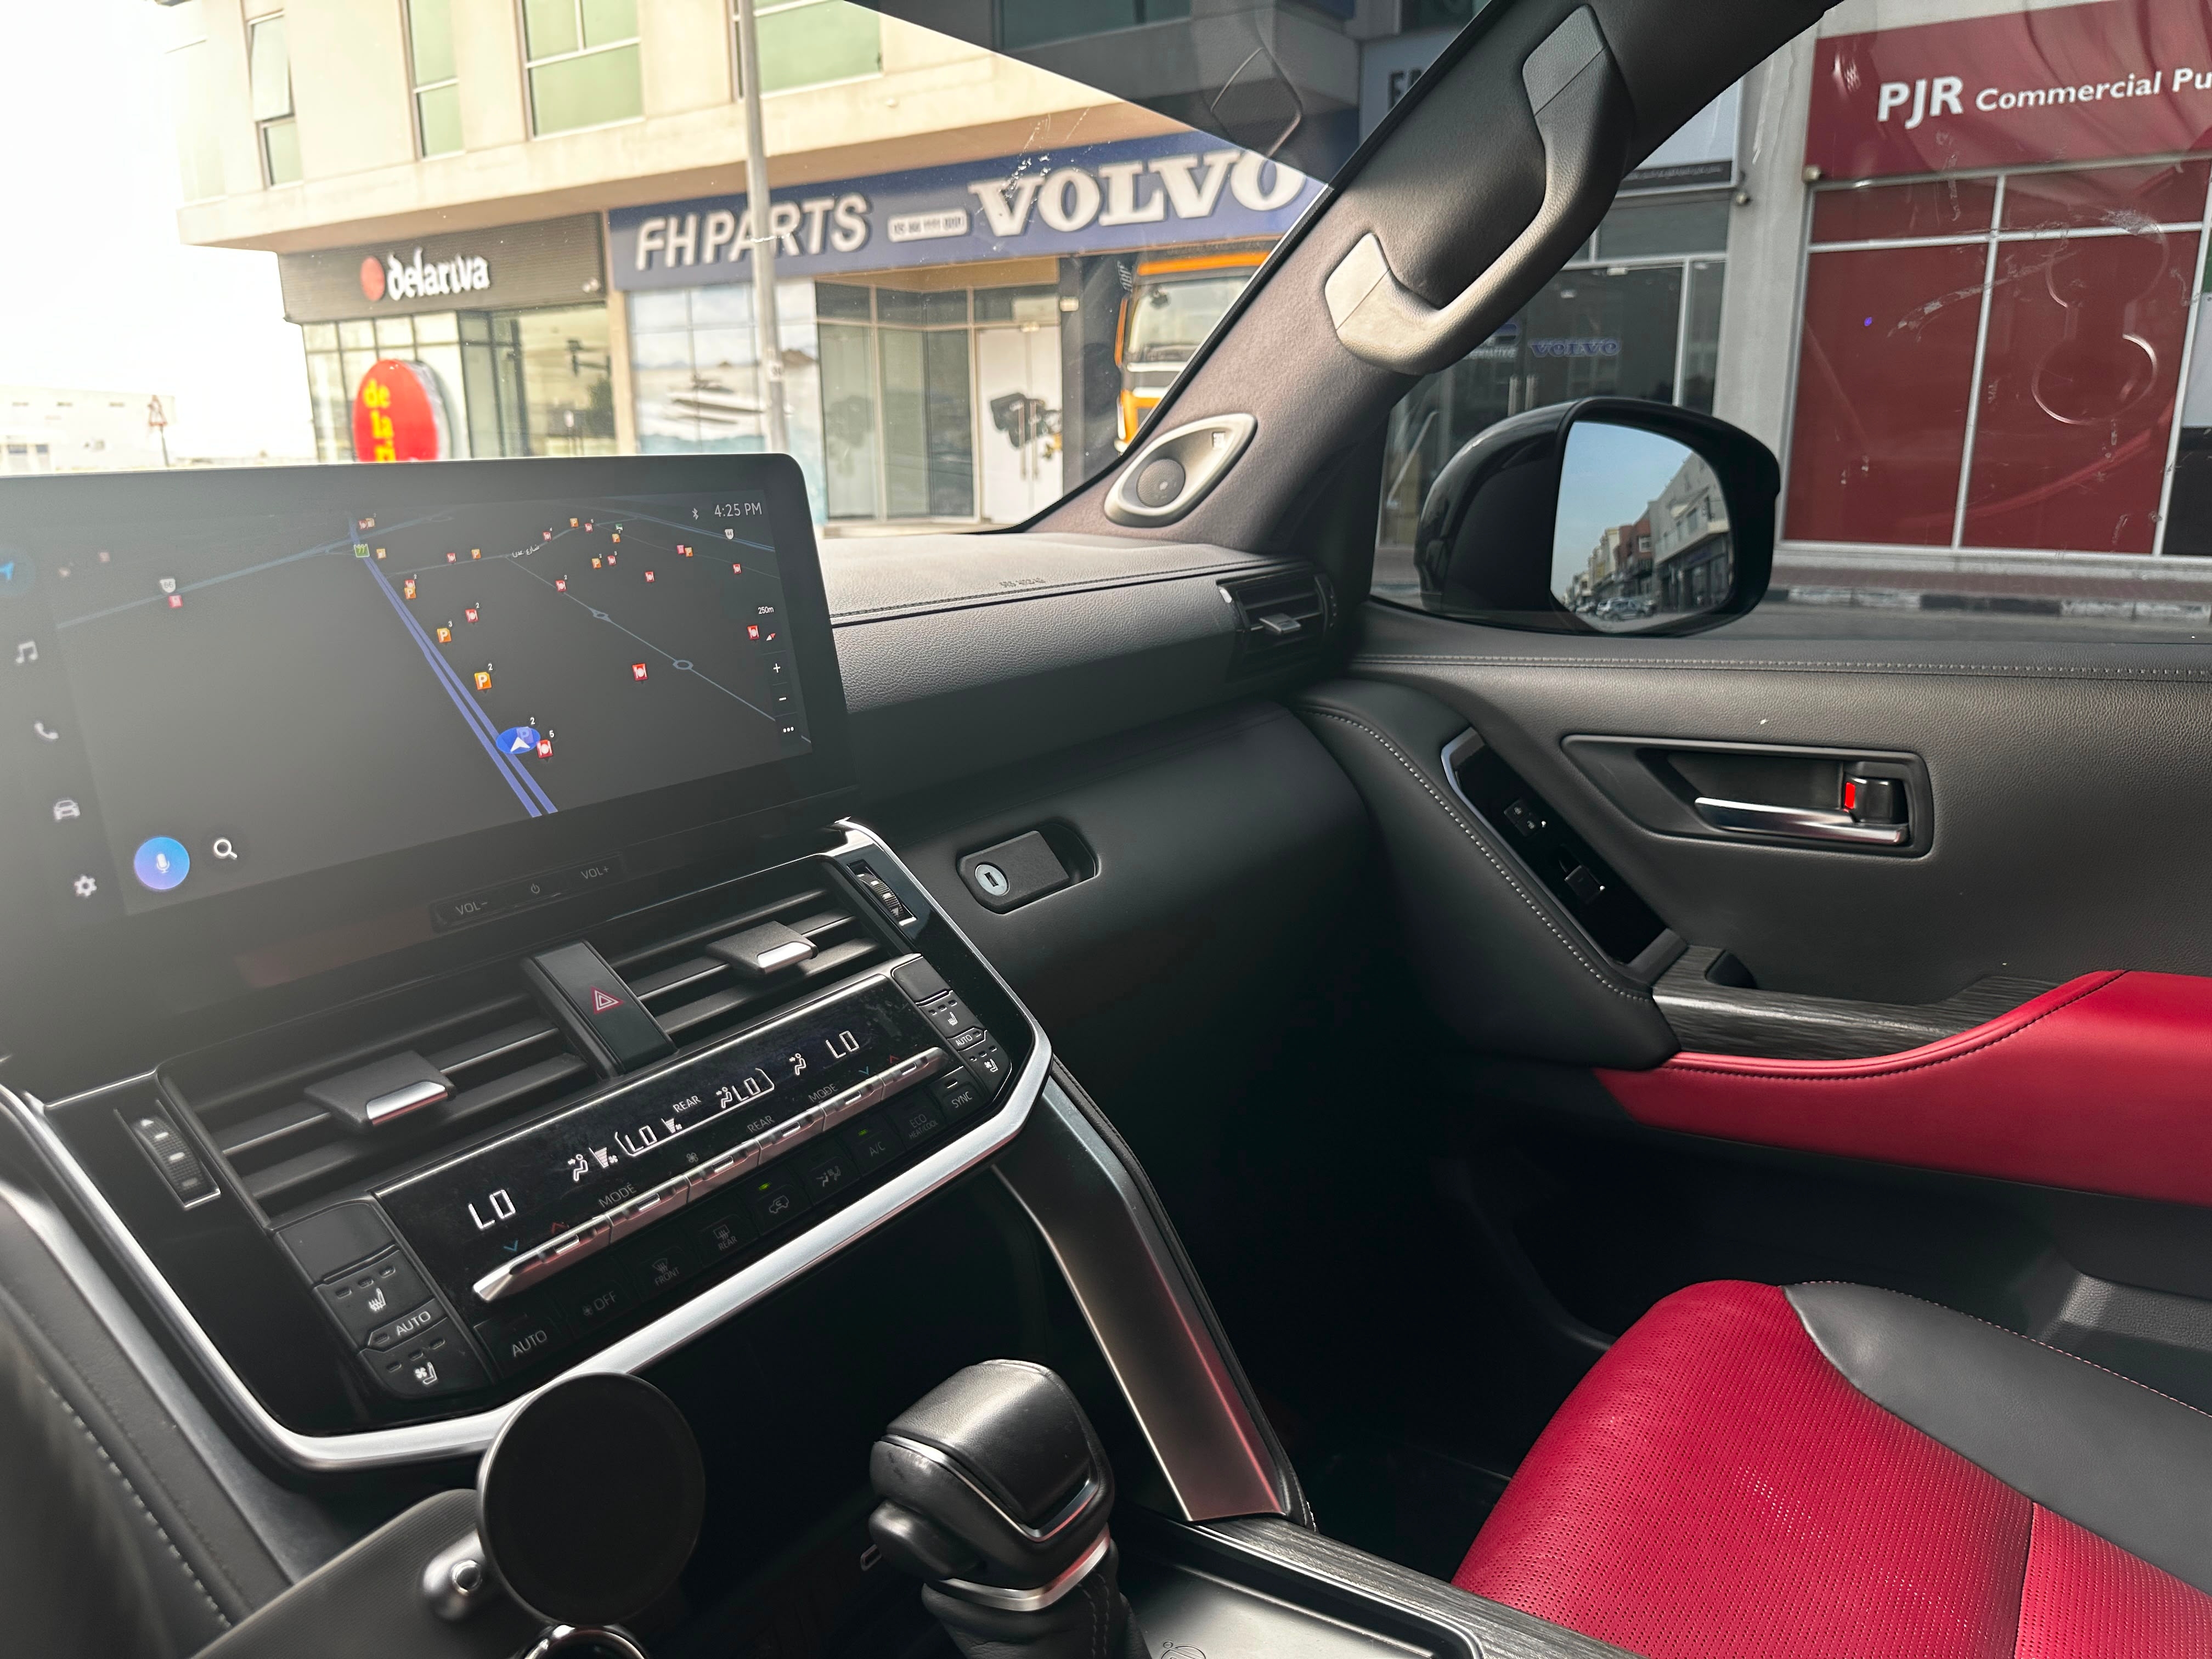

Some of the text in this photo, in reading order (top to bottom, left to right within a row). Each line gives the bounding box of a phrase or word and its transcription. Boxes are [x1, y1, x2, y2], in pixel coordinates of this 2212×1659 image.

[1877, 76, 1963, 129] PJR
[1976, 71, 2162, 111] Commercial
[968, 148, 1307, 237] VOLVO
[387, 247, 490, 301] delariva
[1530, 341, 1620, 357] VOLVO
[363, 378, 391, 408] de
[371, 409, 394, 438] la
[714, 502, 762, 517] 4:25 PM
[758, 606, 774, 614] 250m
[955, 1034, 973, 1046] AUTO
[808, 1084, 839, 1103] MODE
[951, 1091, 973, 1108] SYNC
[673, 1095, 702, 1113] REAR
[747, 1115, 775, 1133] REAR
[909, 1120, 938, 1139] HEAT/COOL
[910, 1114, 927, 1128] ECO
[869, 1141, 886, 1156] A/C
[599, 1183, 637, 1207] MODE
[718, 1235, 737, 1251] REAR
[654, 1267, 680, 1286] FRONT
[594, 1291, 618, 1311] OFF
[396, 1311, 431, 1336] AUTO
[512, 1329, 547, 1357] AUTO
